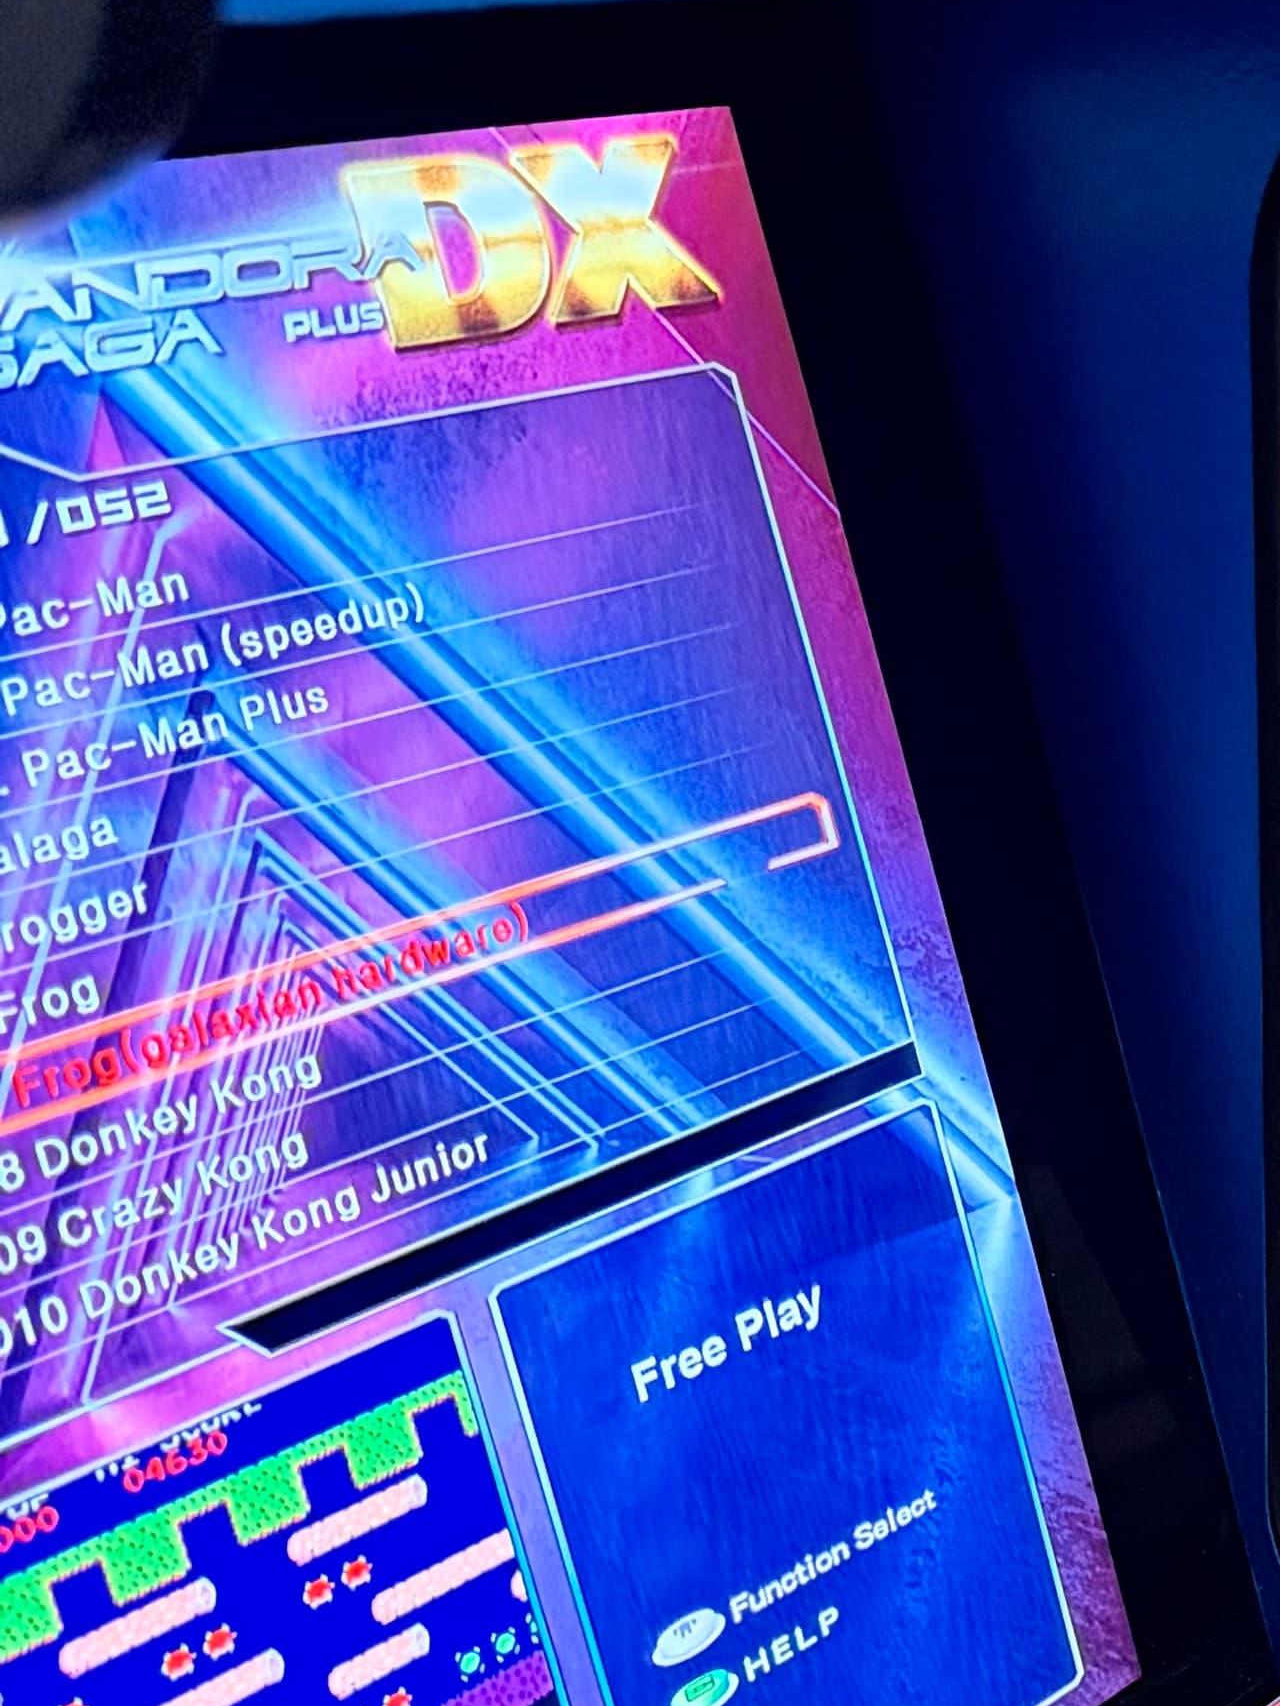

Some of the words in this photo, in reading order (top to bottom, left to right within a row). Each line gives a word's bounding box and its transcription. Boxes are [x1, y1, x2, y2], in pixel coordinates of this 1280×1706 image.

[342, 135, 721, 351] DX
[283, 301, 384, 343] PLUS
[0, 571, 190, 637] ac-Man
[1, 640, 209, 717] Pac-Man
[221, 581, 425, 666] (speedup)
[21, 711, 229, 788] Pac-Man
[239, 685, 330, 731] Plus
[331, 900, 529, 999] hardware)
[35, 1094, 198, 1178] Donkey
[211, 1053, 323, 1113] Kong
[57, 1174, 185, 1248] Crazy
[197, 1132, 310, 1195] Kong
[79, 1231, 240, 1320] Donkey
[251, 1186, 361, 1250] Kong
[371, 1132, 489, 1204] Junior
[631, 1334, 727, 1403] Free
[735, 1284, 821, 1352] Play
[122, 1431, 228, 1493] 04630
[728, 1541, 851, 1625] Function
[852, 1488, 937, 1550] Select
[743, 1606, 839, 1682] HELP
